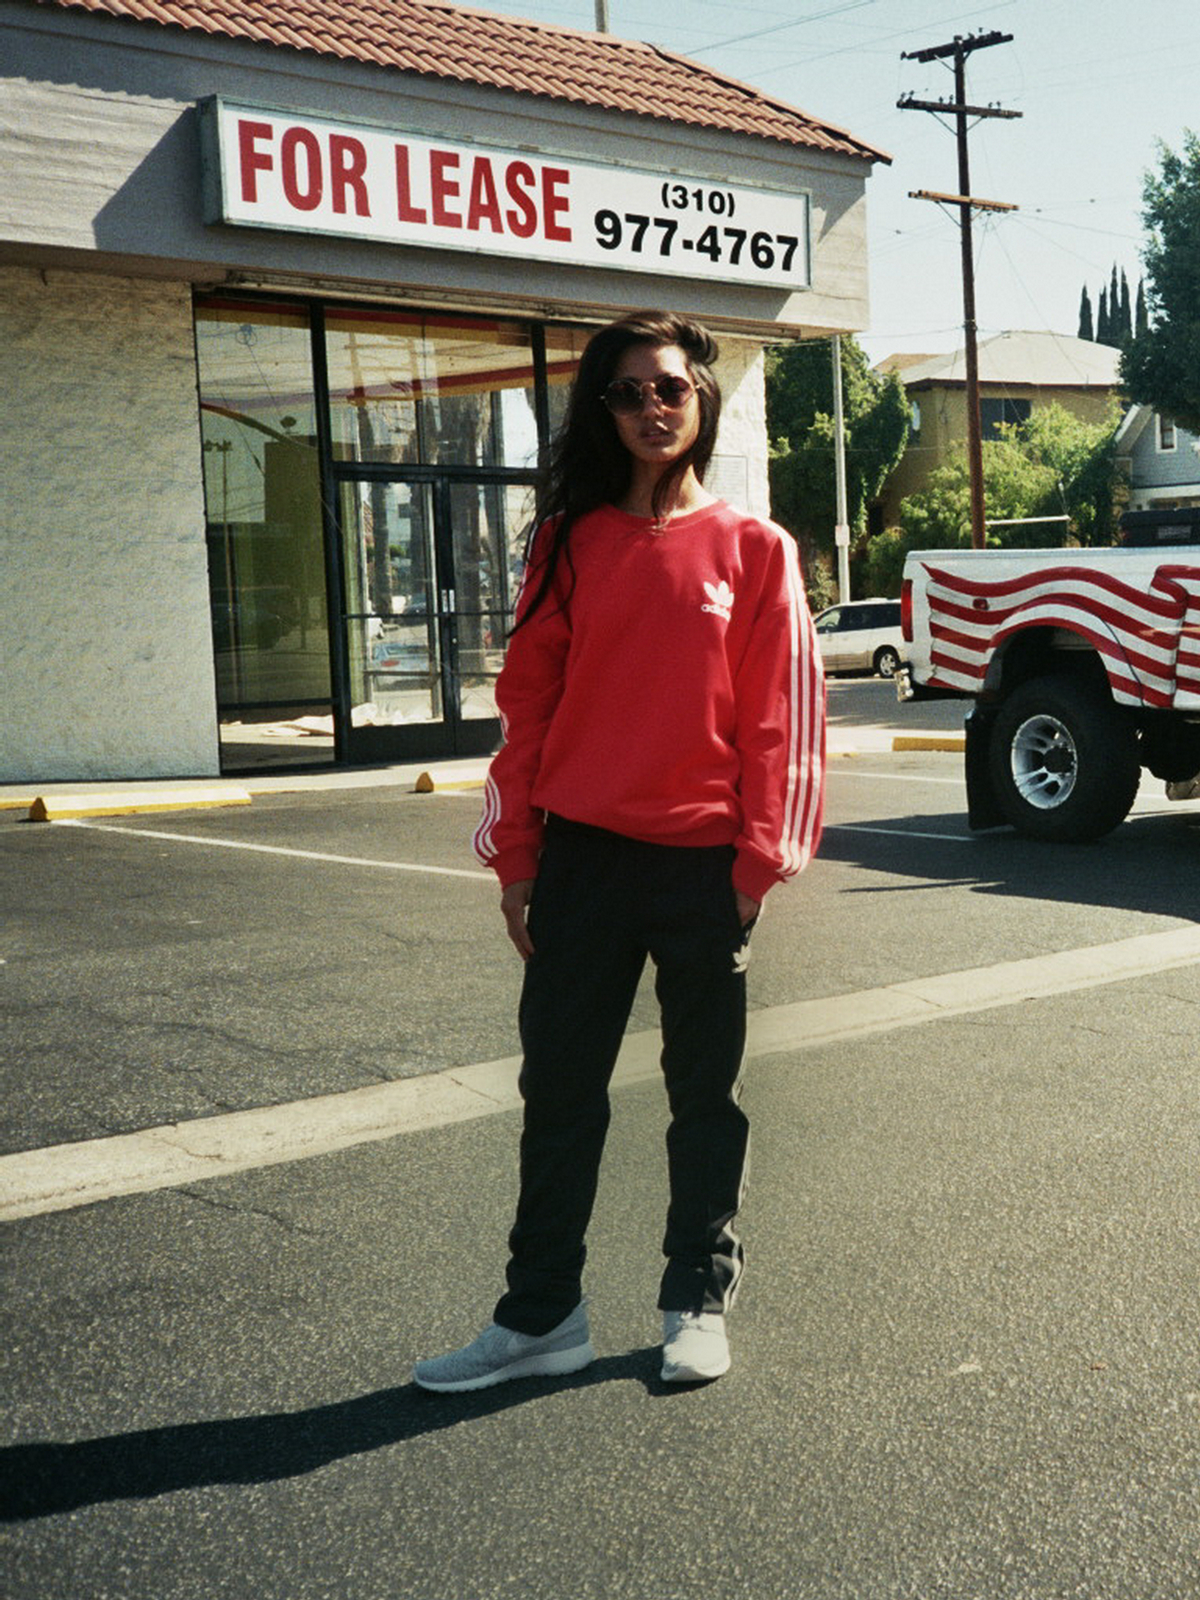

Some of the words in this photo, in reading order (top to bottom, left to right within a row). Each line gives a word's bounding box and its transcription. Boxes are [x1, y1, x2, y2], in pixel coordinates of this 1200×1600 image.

[238, 119, 371, 217] FOR
[394, 144, 571, 243] LEASE
[661, 182, 735, 218] (310)
[594, 209, 799, 272] 977-4767
